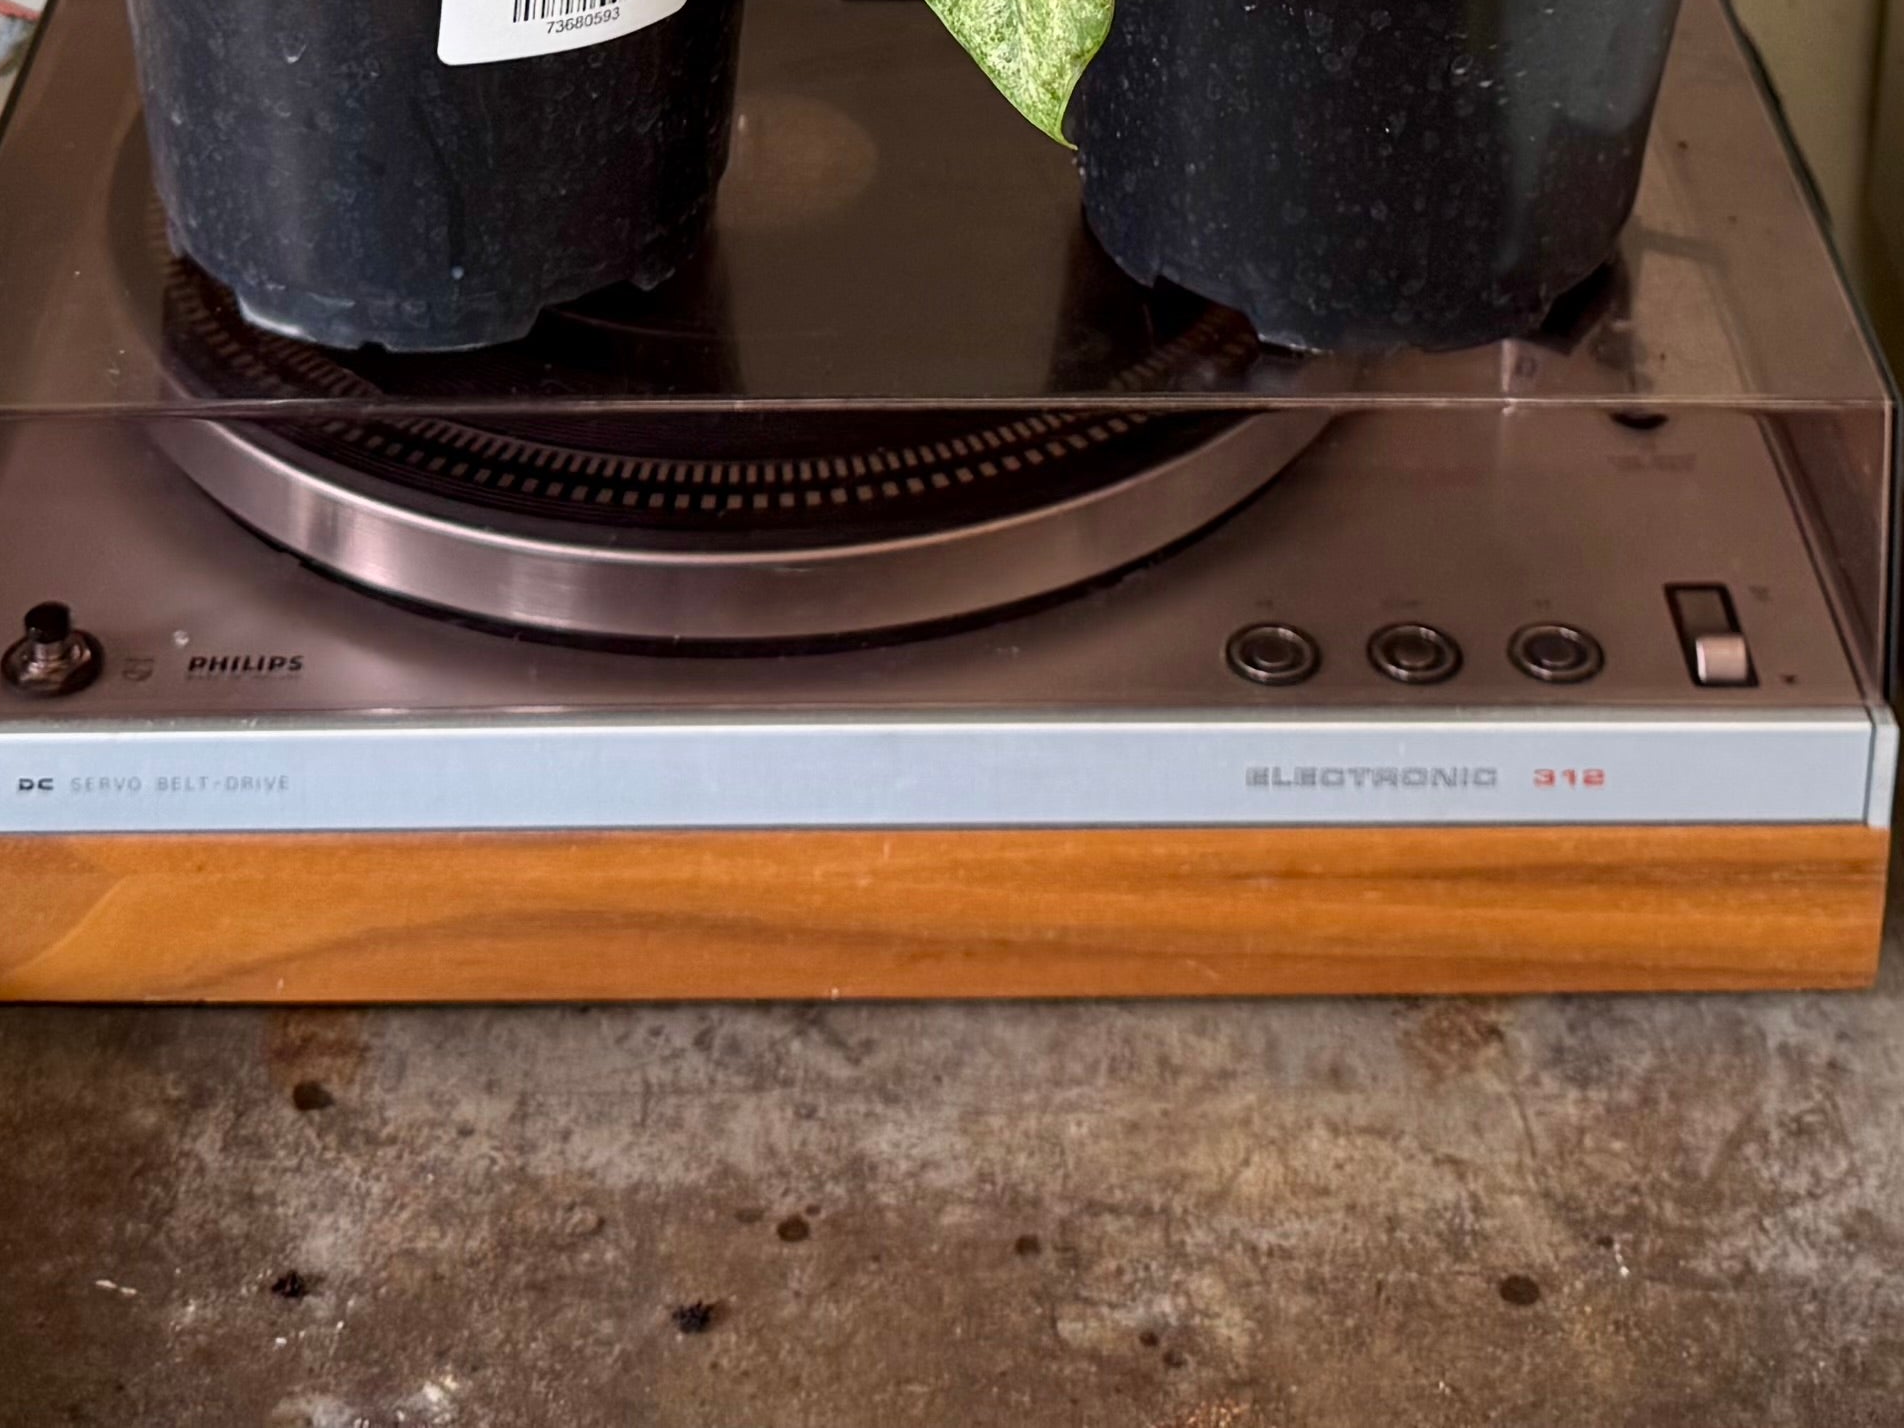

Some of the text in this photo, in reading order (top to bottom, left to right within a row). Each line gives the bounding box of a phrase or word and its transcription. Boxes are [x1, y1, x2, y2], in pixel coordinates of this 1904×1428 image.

[547, 7, 620, 34] 73680593
[188, 655, 304, 672] PHILIPS
[18, 775, 290, 792] DC SERVO BELT-DRIVE
[1245, 767, 1607, 788] ELECTRONIC 312
